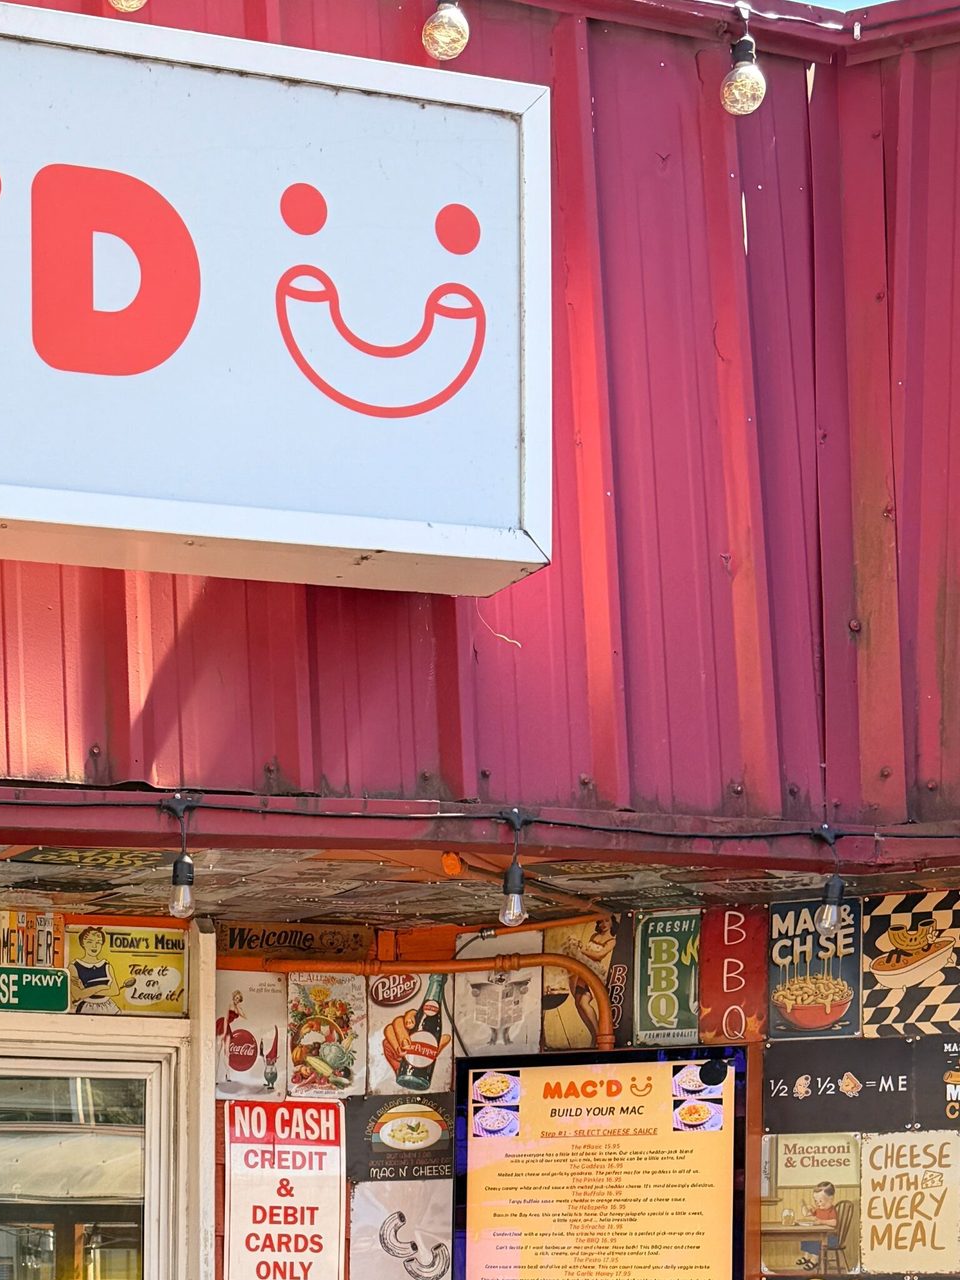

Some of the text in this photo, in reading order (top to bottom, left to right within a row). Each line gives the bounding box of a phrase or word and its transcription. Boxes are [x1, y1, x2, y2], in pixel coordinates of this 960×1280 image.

[648, 920, 695, 933] FRESH!
[108, 932, 185, 950] TODAY'S MENU
[228, 928, 314, 949] Welcome
[129, 965, 168, 976] Take it
[22, 974, 63, 987] PKWY
[146, 979, 158, 988] or
[377, 974, 417, 1000] Dr Pepper
[131, 988, 183, 1002] Leave it!
[543, 1080, 622, 1099] MAC'D
[550, 1106, 645, 1117] BUILD YOUR MAC
[234, 1107, 335, 1140] NO CASH
[784, 1143, 850, 1154] Macaroni
[869, 1142, 952, 1169] CHEESE
[244, 1150, 327, 1170] CREDIT
[784, 1156, 850, 1168] & Cheese
[277, 1178, 294, 1197] &
[872, 1173, 918, 1192] WITH
[868, 1187, 948, 1220] EVERY
[252, 1206, 319, 1225] DEBIT
[245, 1233, 323, 1253] CARDS
[870, 1221, 945, 1251] MEAL
[256, 1261, 313, 1280] ONLY
